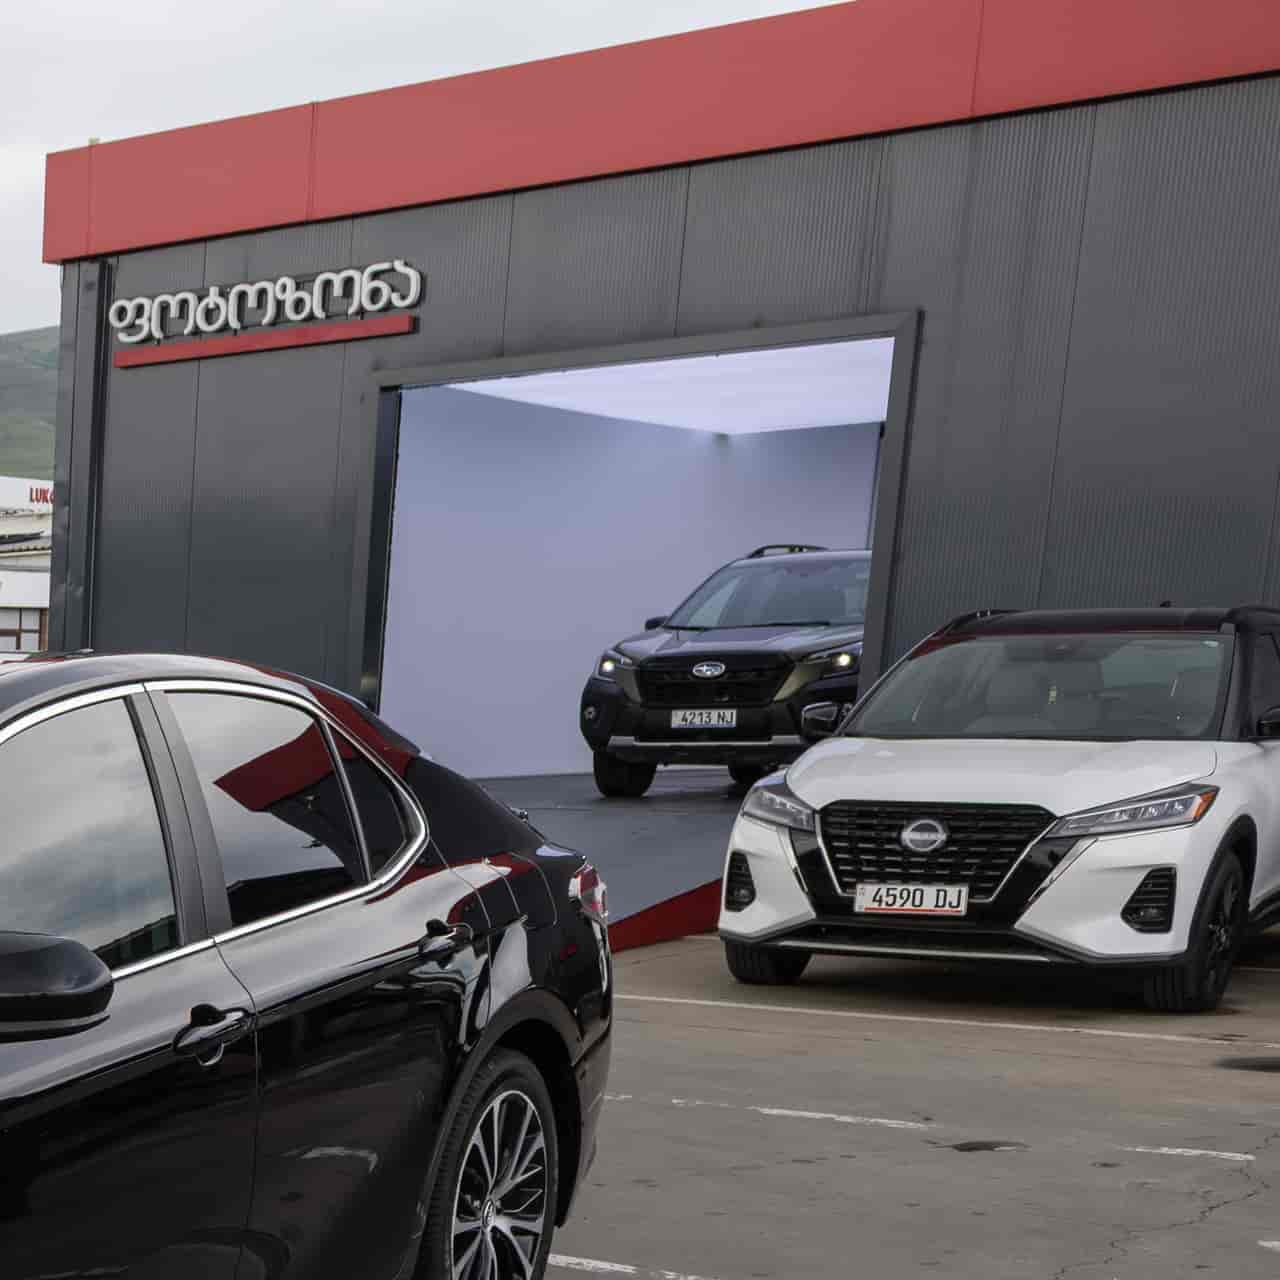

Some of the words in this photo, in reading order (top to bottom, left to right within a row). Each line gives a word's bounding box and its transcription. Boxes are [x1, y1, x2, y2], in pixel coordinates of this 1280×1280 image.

[109, 259, 422, 344] ფოტოზონა
[681, 711, 712, 725] 4213
[717, 711, 733, 724] NJ
[872, 887, 925, 907] 4590
[934, 888, 962, 909] DJ
